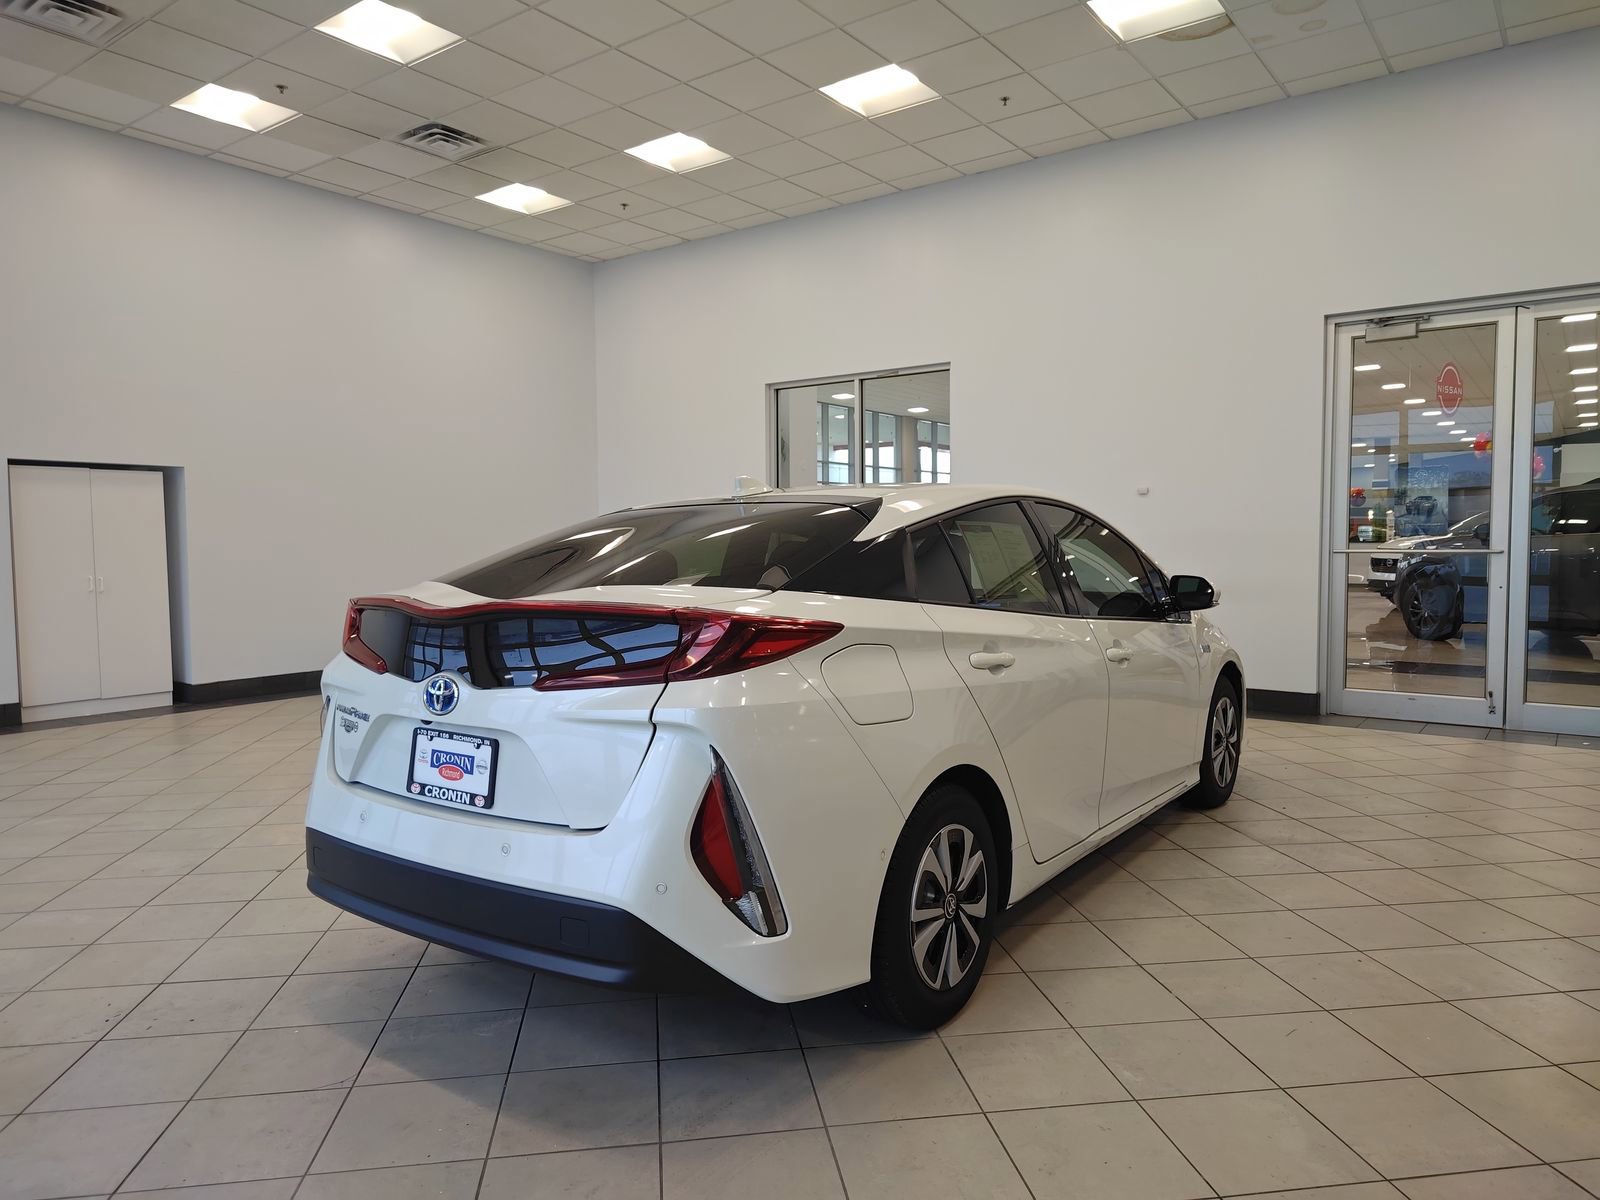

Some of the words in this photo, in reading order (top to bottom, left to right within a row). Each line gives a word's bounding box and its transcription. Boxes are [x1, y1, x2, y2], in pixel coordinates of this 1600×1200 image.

[1437, 384, 1463, 395] NISSAN
[433, 752, 472, 772] CRONIN
[424, 785, 470, 804] CRONIN
